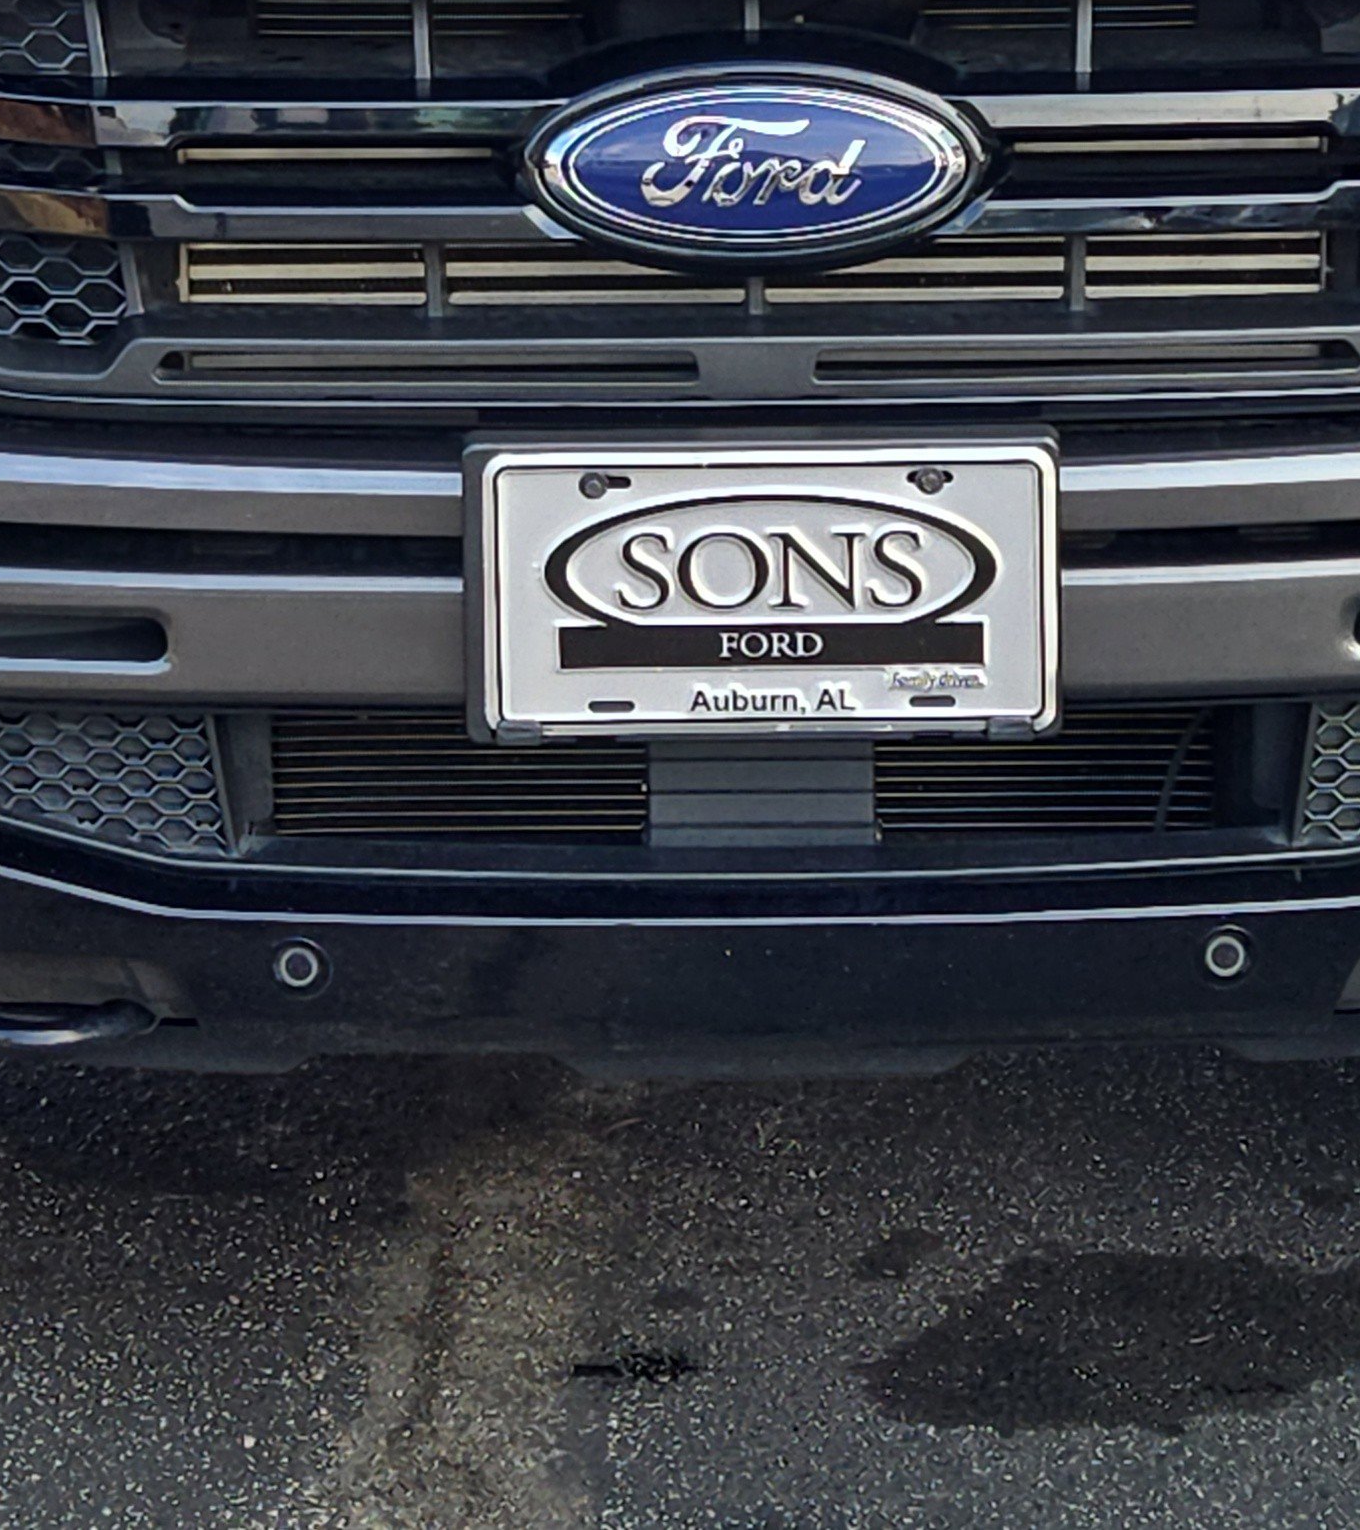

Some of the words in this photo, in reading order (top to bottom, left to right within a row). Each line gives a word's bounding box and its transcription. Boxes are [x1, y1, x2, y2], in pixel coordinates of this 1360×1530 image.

[641, 115, 866, 207] Ford
[615, 530, 923, 611] SONS
[719, 631, 824, 658] FORD
[690, 689, 807, 715] Auburn,
[816, 689, 857, 712] AL
